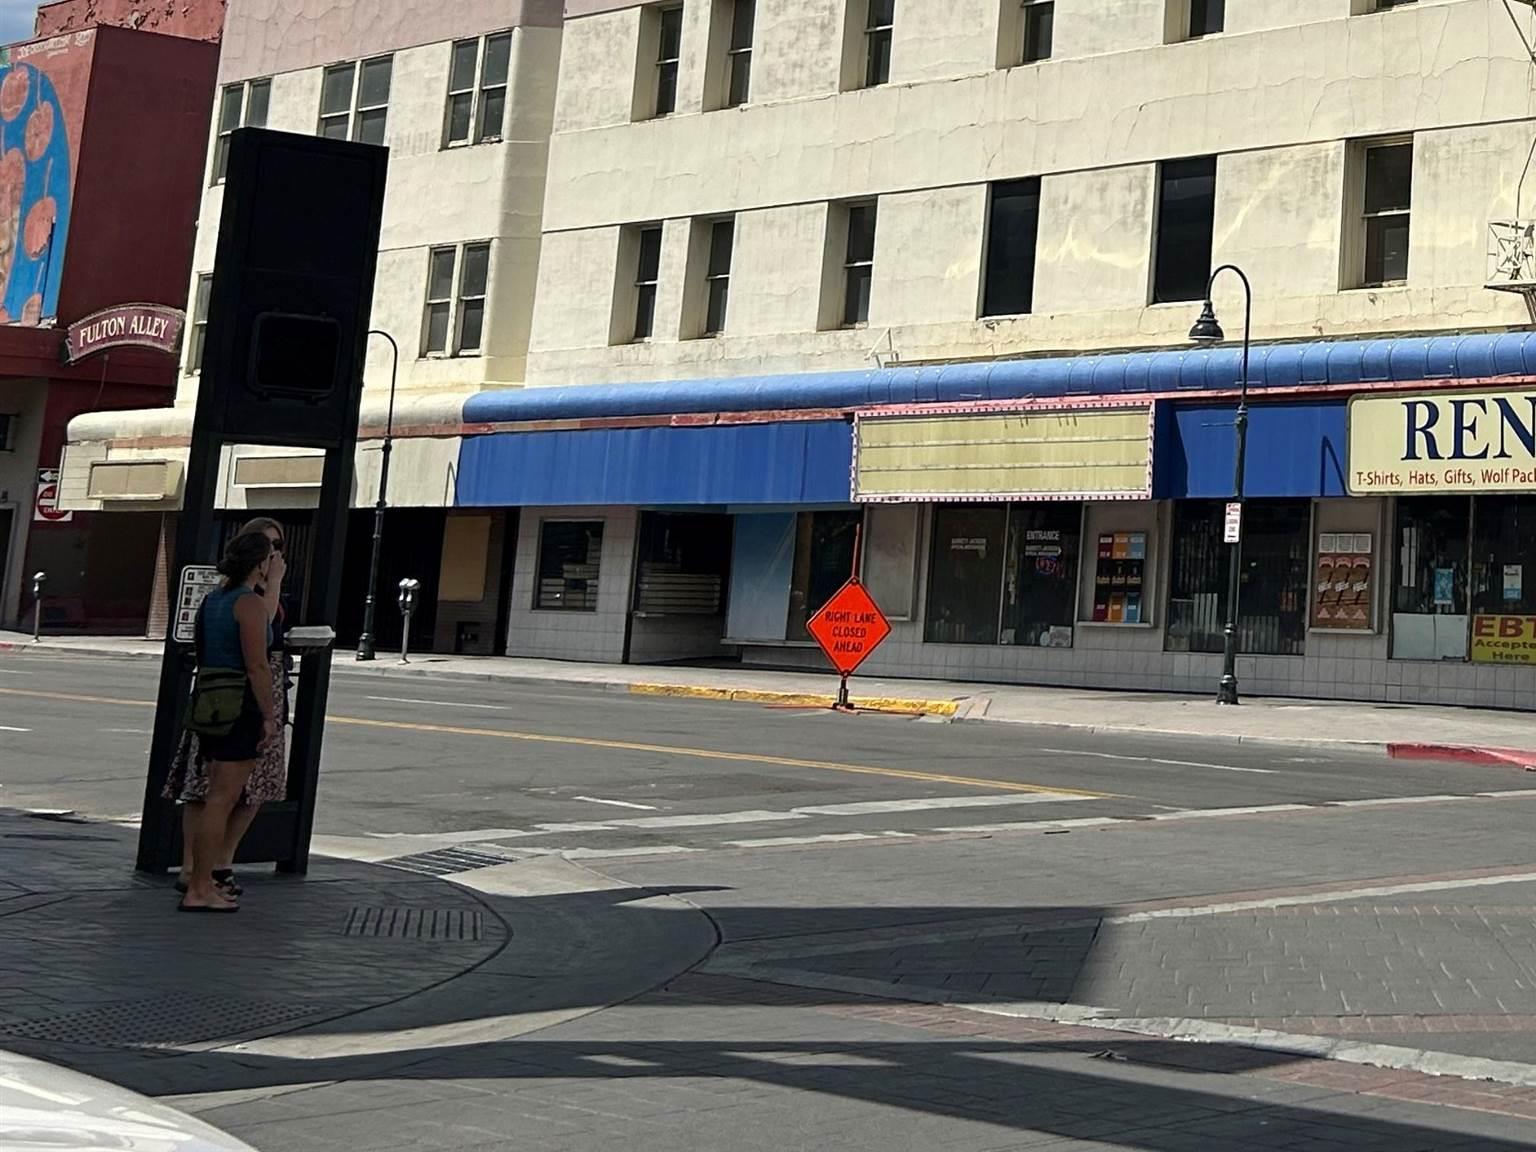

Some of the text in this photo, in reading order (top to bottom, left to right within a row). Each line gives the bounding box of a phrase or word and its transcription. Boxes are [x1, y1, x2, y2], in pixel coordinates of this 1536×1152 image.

[80, 315, 168, 347] FULTON ALLEY
[1356, 471, 1403, 486] T-Shirts,
[1409, 470, 1438, 485] Hats,
[1444, 469, 1475, 486] Gifts,
[1481, 468, 1509, 484] Wolf
[1026, 530, 1060, 540] ENTRANCE
[825, 611, 877, 624] RIGHT LANE
[832, 626, 866, 638] CLOSED
[833, 641, 863, 653] AHEAD
[1493, 651, 1530, 661] Here
